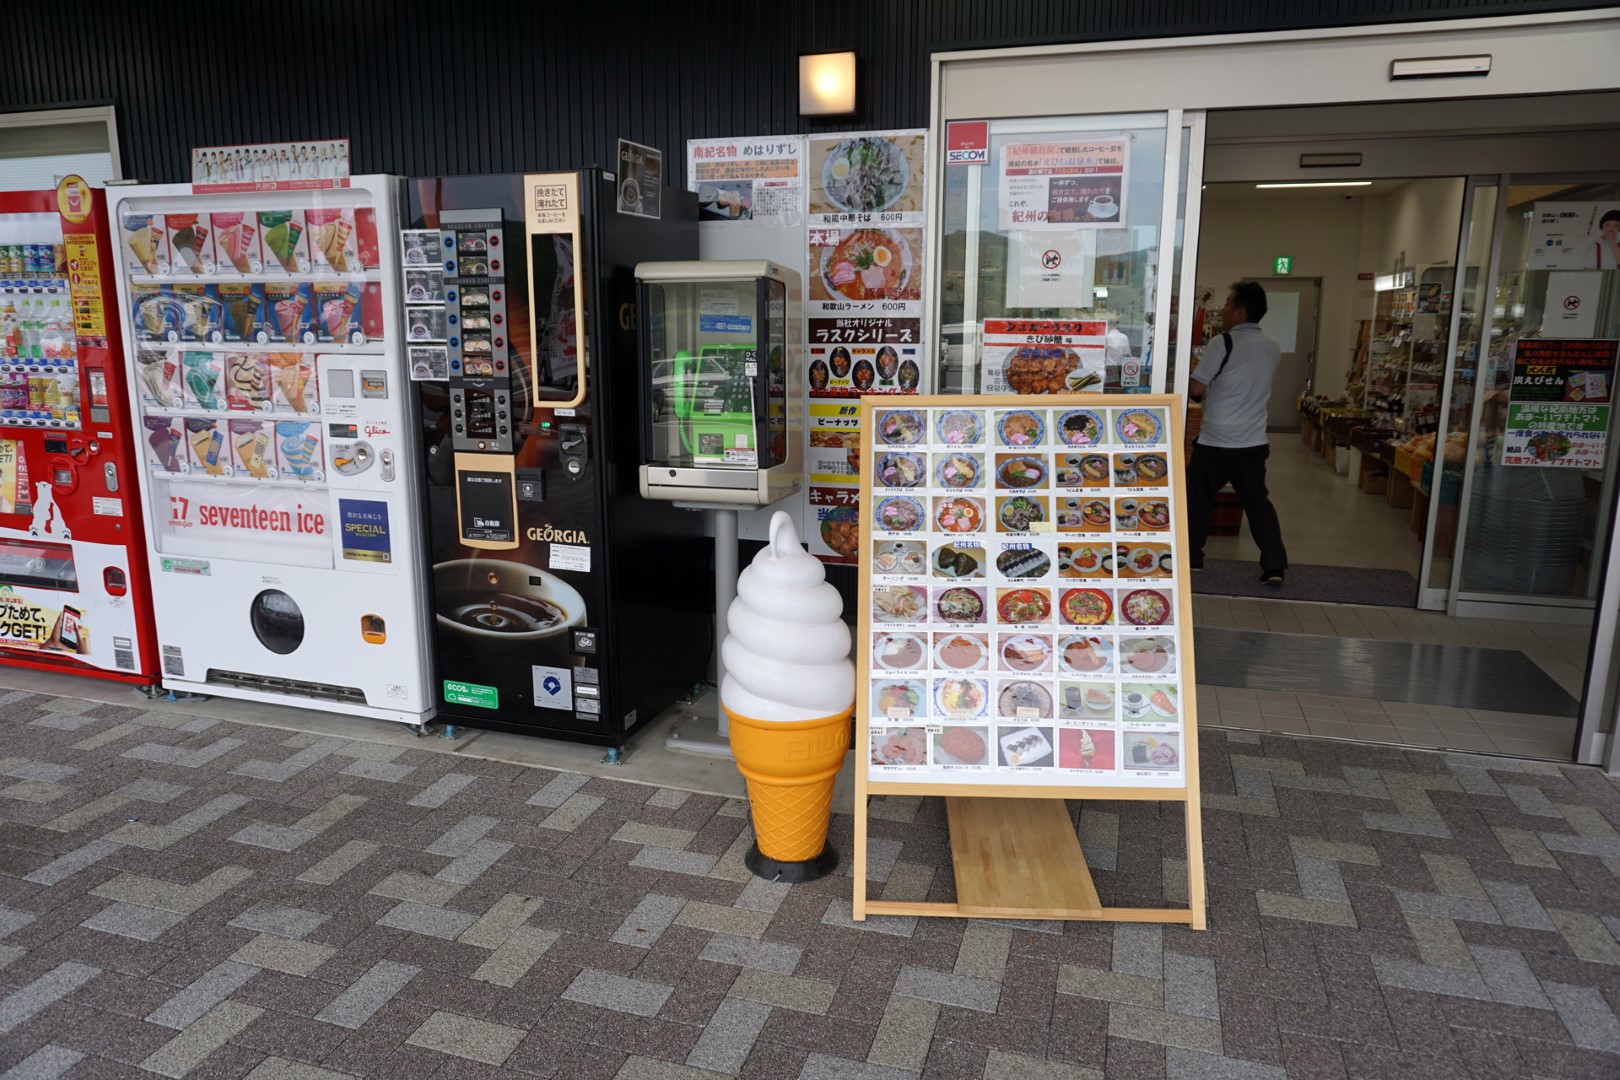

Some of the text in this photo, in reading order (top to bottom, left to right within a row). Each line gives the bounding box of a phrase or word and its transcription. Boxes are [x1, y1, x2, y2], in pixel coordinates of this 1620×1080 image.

[694, 144, 796, 158] 南紀名物 めはりずし
[949, 150, 986, 160] SECOM
[621, 150, 643, 164] GEORGIA
[537, 187, 564, 197] 挽きたて
[823, 213, 903, 223] 和風中華そば 600円
[809, 231, 840, 246] 本場
[822, 303, 906, 311] 和歌山ラーメン 600円
[836, 319, 892, 327] 当社オリジナル
[1006, 322, 1082, 332] シュガーラスク
[816, 329, 912, 342] ラスクシリーズ
[1026, 336, 1063, 344] きび砂糖
[1528, 366, 1554, 374] 大人気
[1513, 375, 1564, 385] 炭えびせん
[364, 426, 390, 437] Glico
[199, 504, 325, 535] seventeen ice
[345, 523, 386, 535] SPECIAL
[526, 523, 590, 544] GEORGIA
